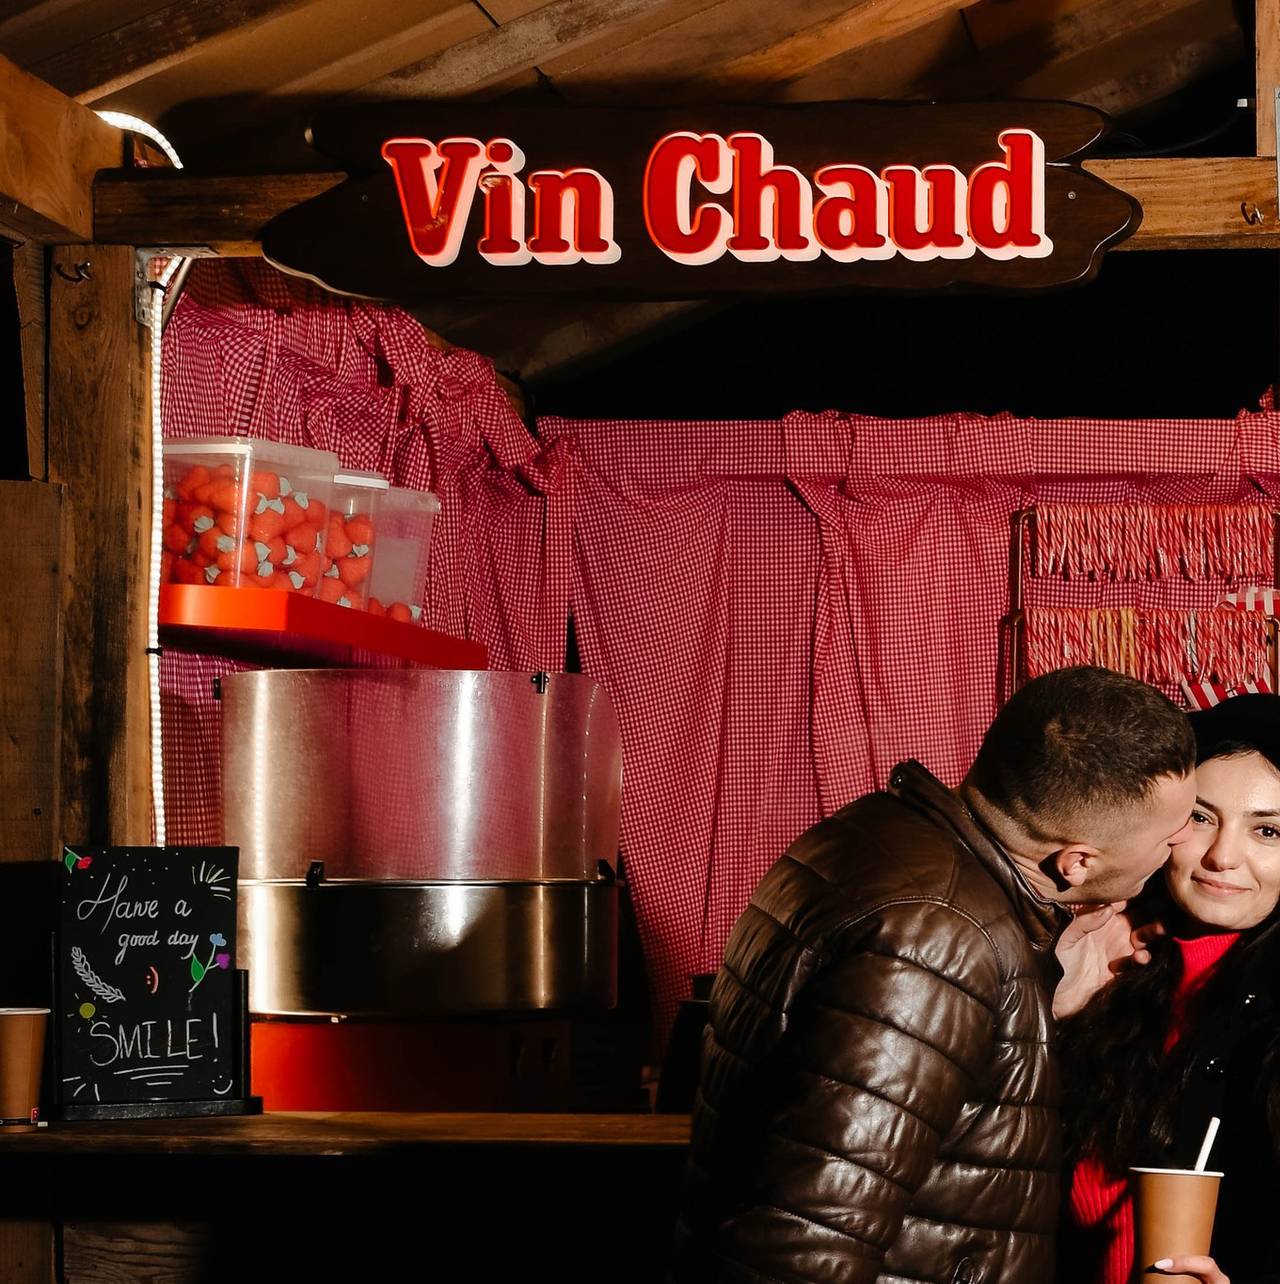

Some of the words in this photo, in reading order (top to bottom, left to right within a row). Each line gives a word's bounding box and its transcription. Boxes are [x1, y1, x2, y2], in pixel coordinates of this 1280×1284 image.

[381, 136, 621, 266] Vin
[642, 128, 1053, 267] Chaud
[77, 873, 159, 935] Have
[174, 899, 192, 917] a
[115, 930, 160, 965] good
[167, 930, 199, 960] day
